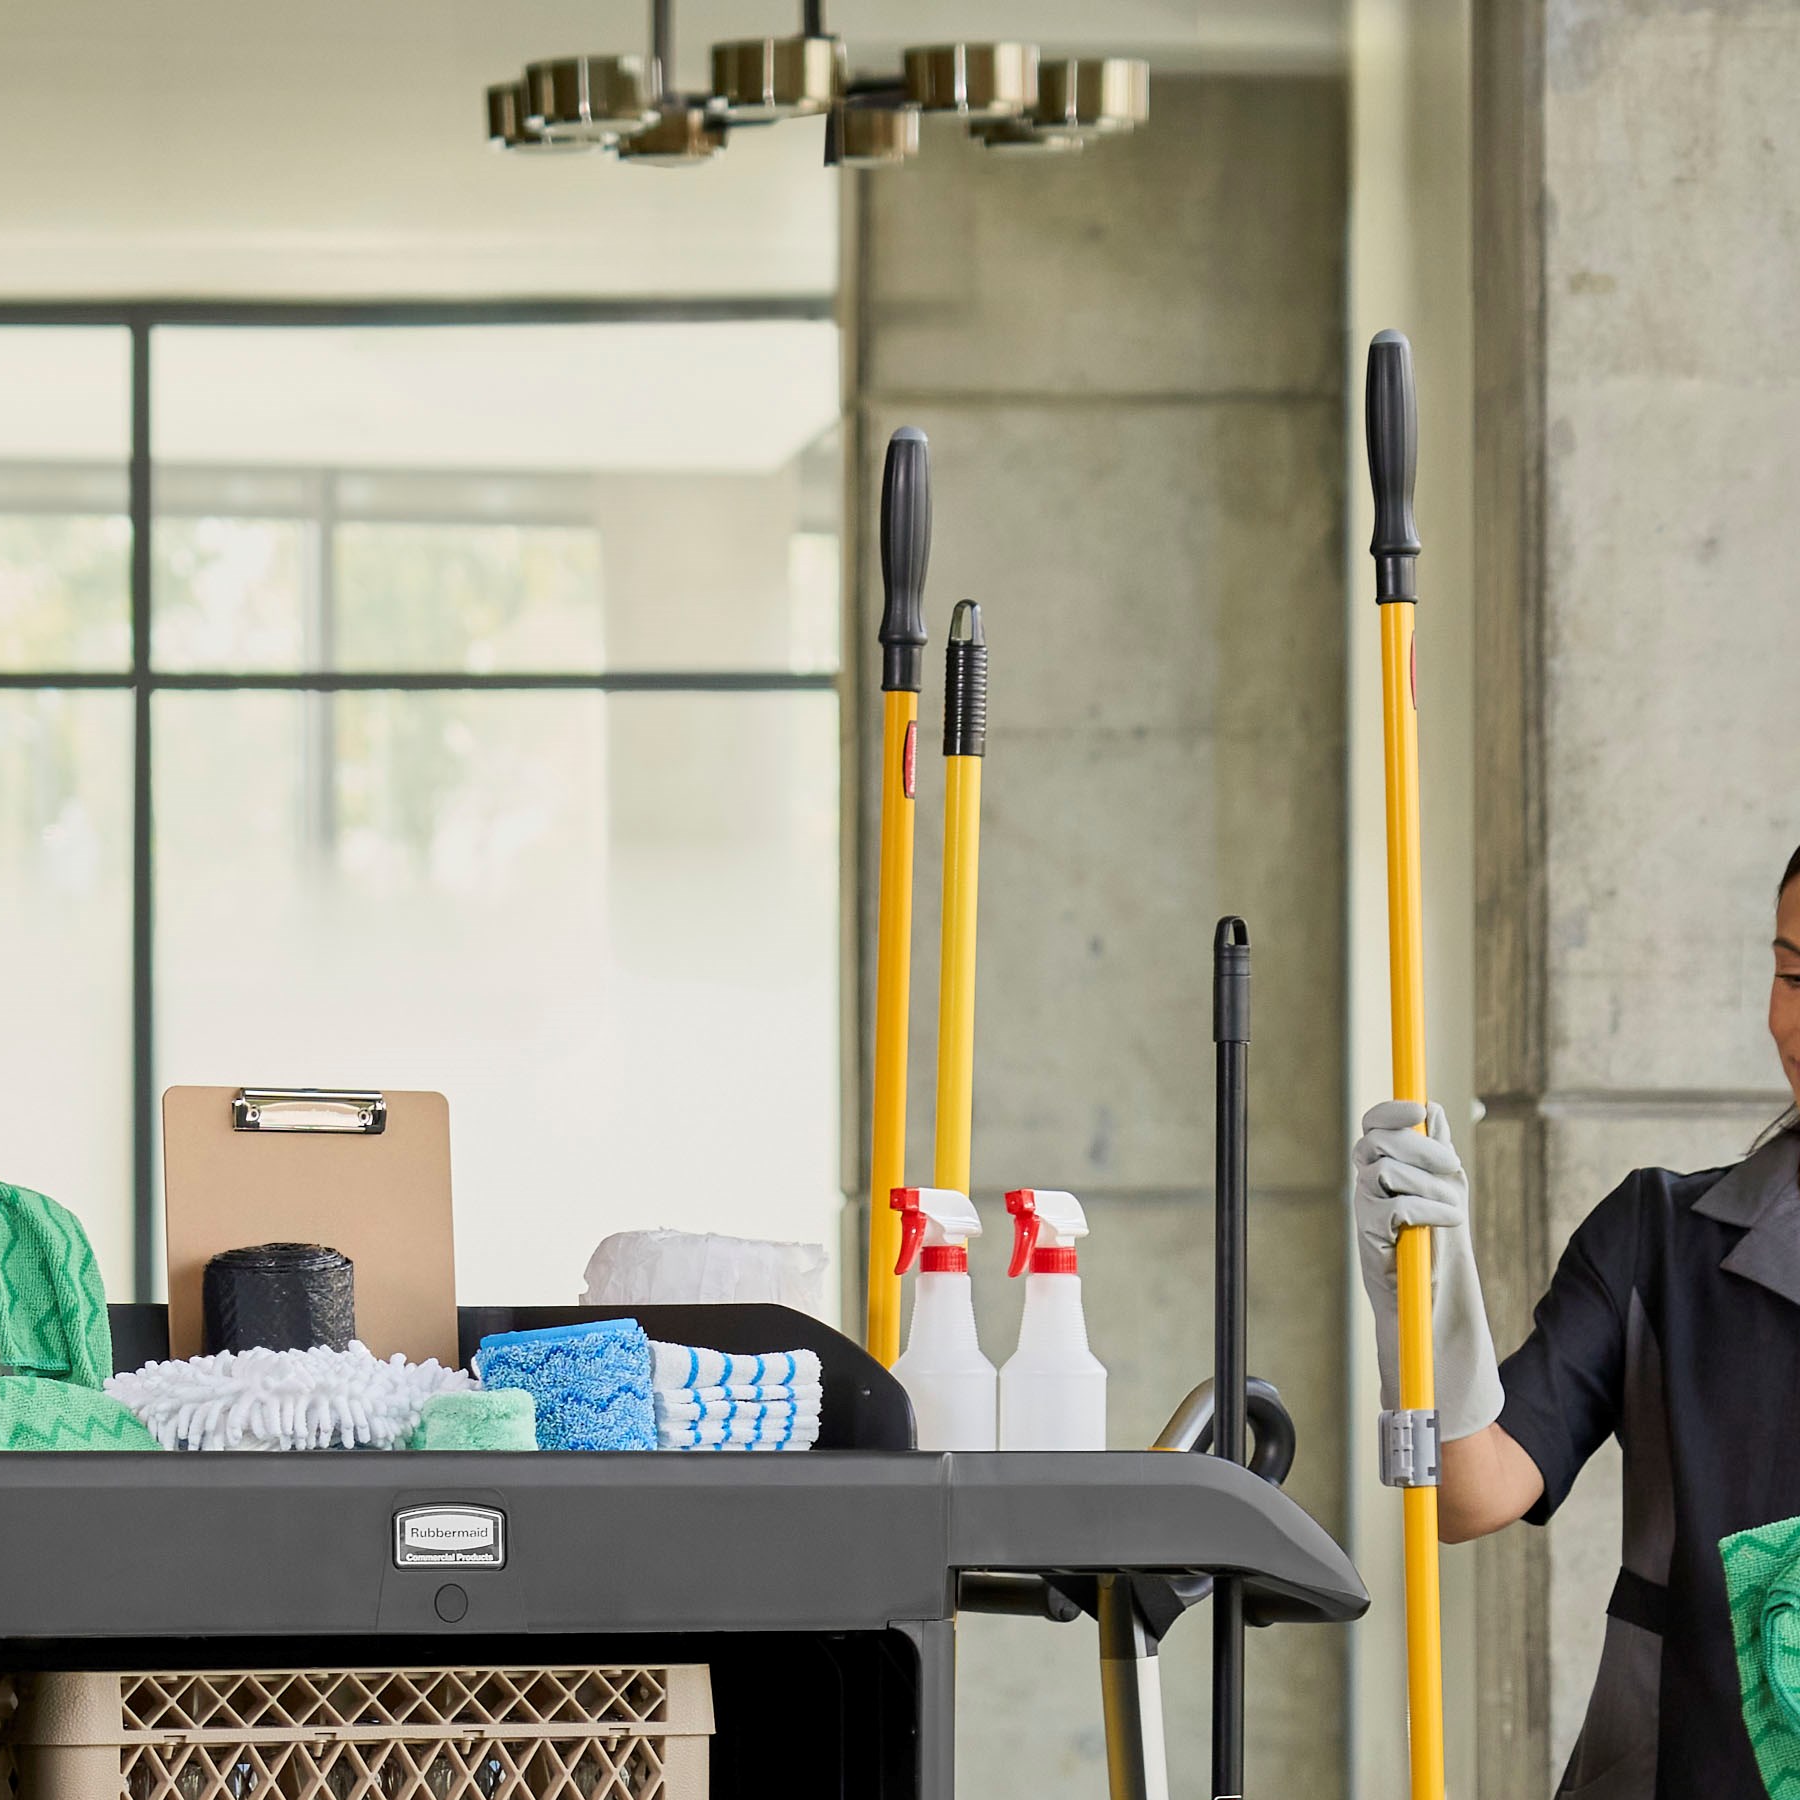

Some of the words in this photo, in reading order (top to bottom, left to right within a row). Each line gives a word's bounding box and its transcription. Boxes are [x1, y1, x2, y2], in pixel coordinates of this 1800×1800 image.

[410, 1527, 489, 1539] Rubbermaid
[405, 1553, 455, 1562] Commercial
[456, 1553, 494, 1562] Products
